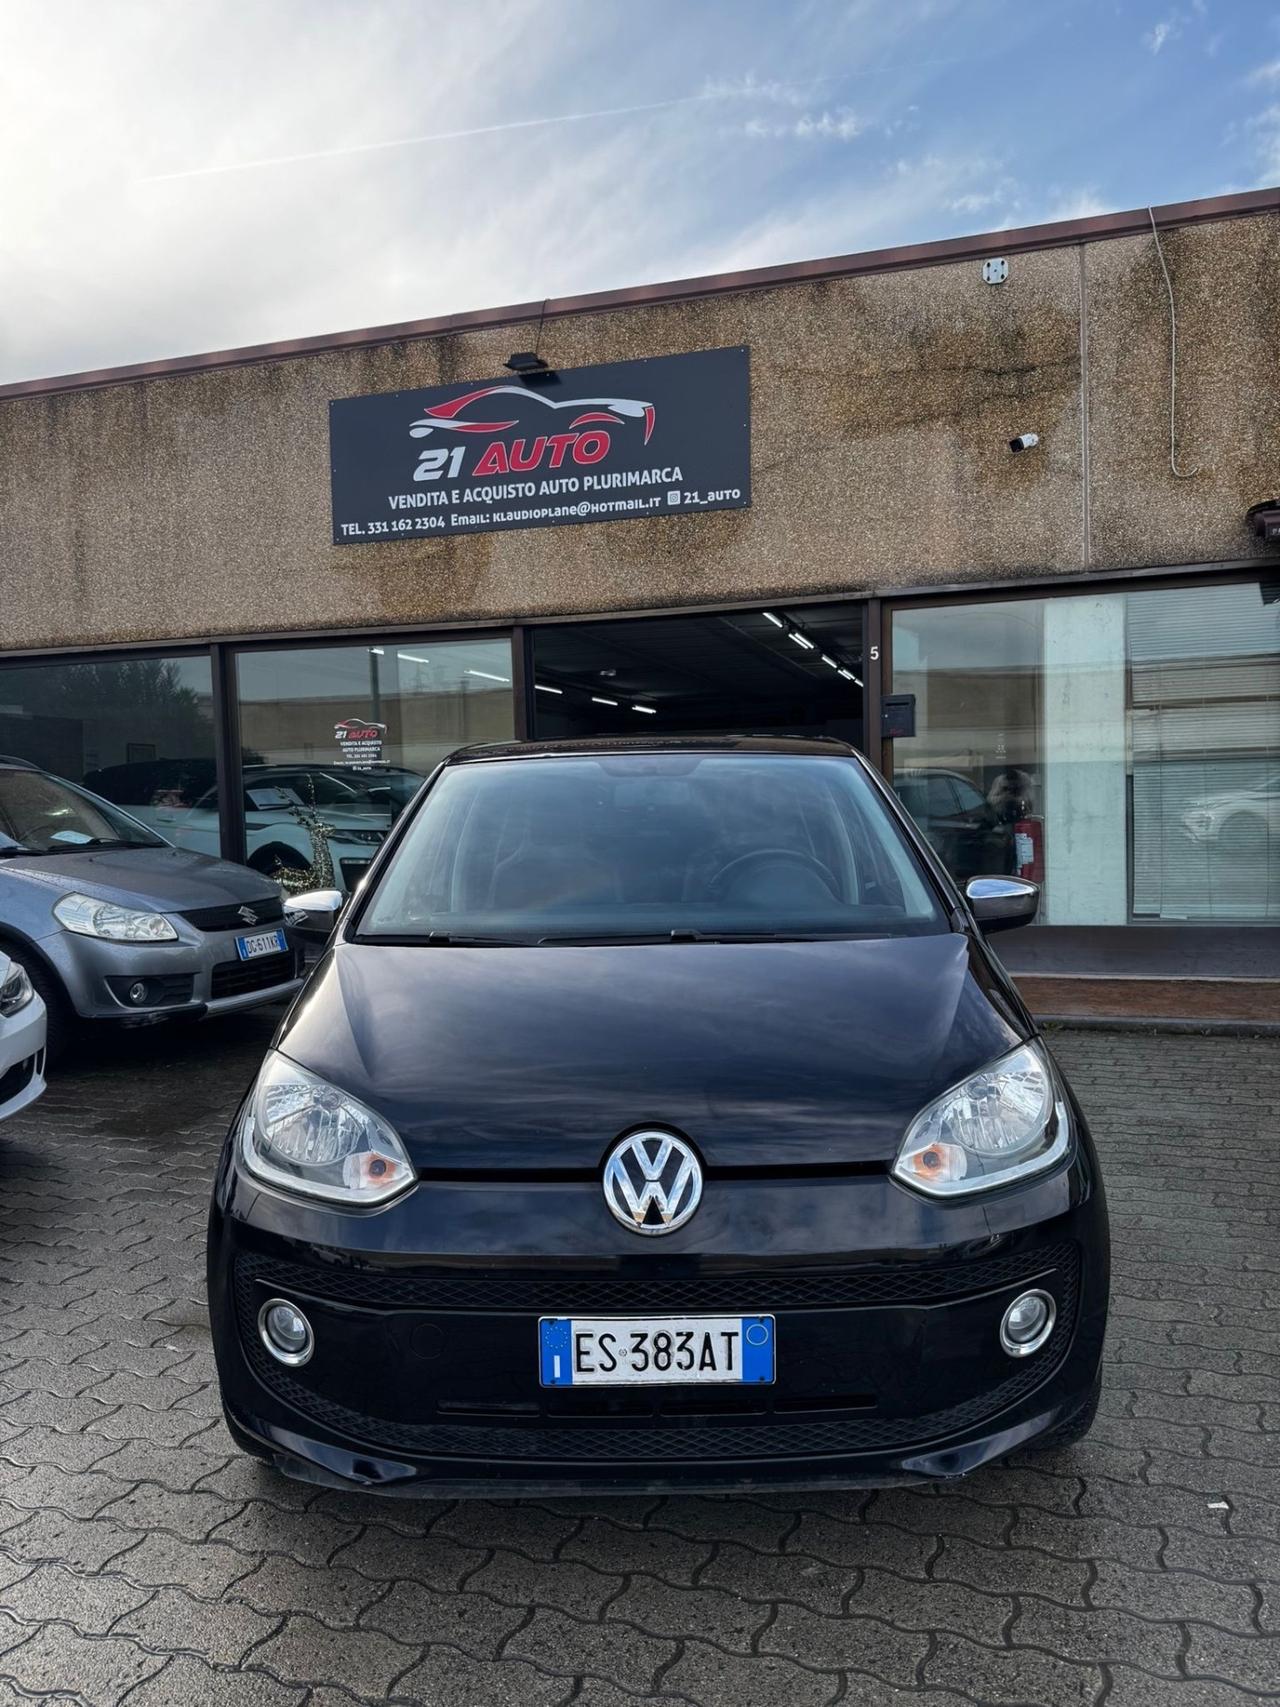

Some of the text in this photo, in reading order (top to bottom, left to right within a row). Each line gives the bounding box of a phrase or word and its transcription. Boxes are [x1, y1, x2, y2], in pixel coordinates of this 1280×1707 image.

[413, 430, 611, 482] 21 AUTO
[388, 467, 684, 510] VENDITA E ACQUISTO AUTO PLURIMARCA
[341, 523, 365, 536] TEL.
[367, 521, 389, 535] 331
[391, 518, 412, 532] 162
[415, 515, 445, 530] 2304
[870, 646, 879, 660] 5
[335, 729, 378, 739] 21 AUTO
